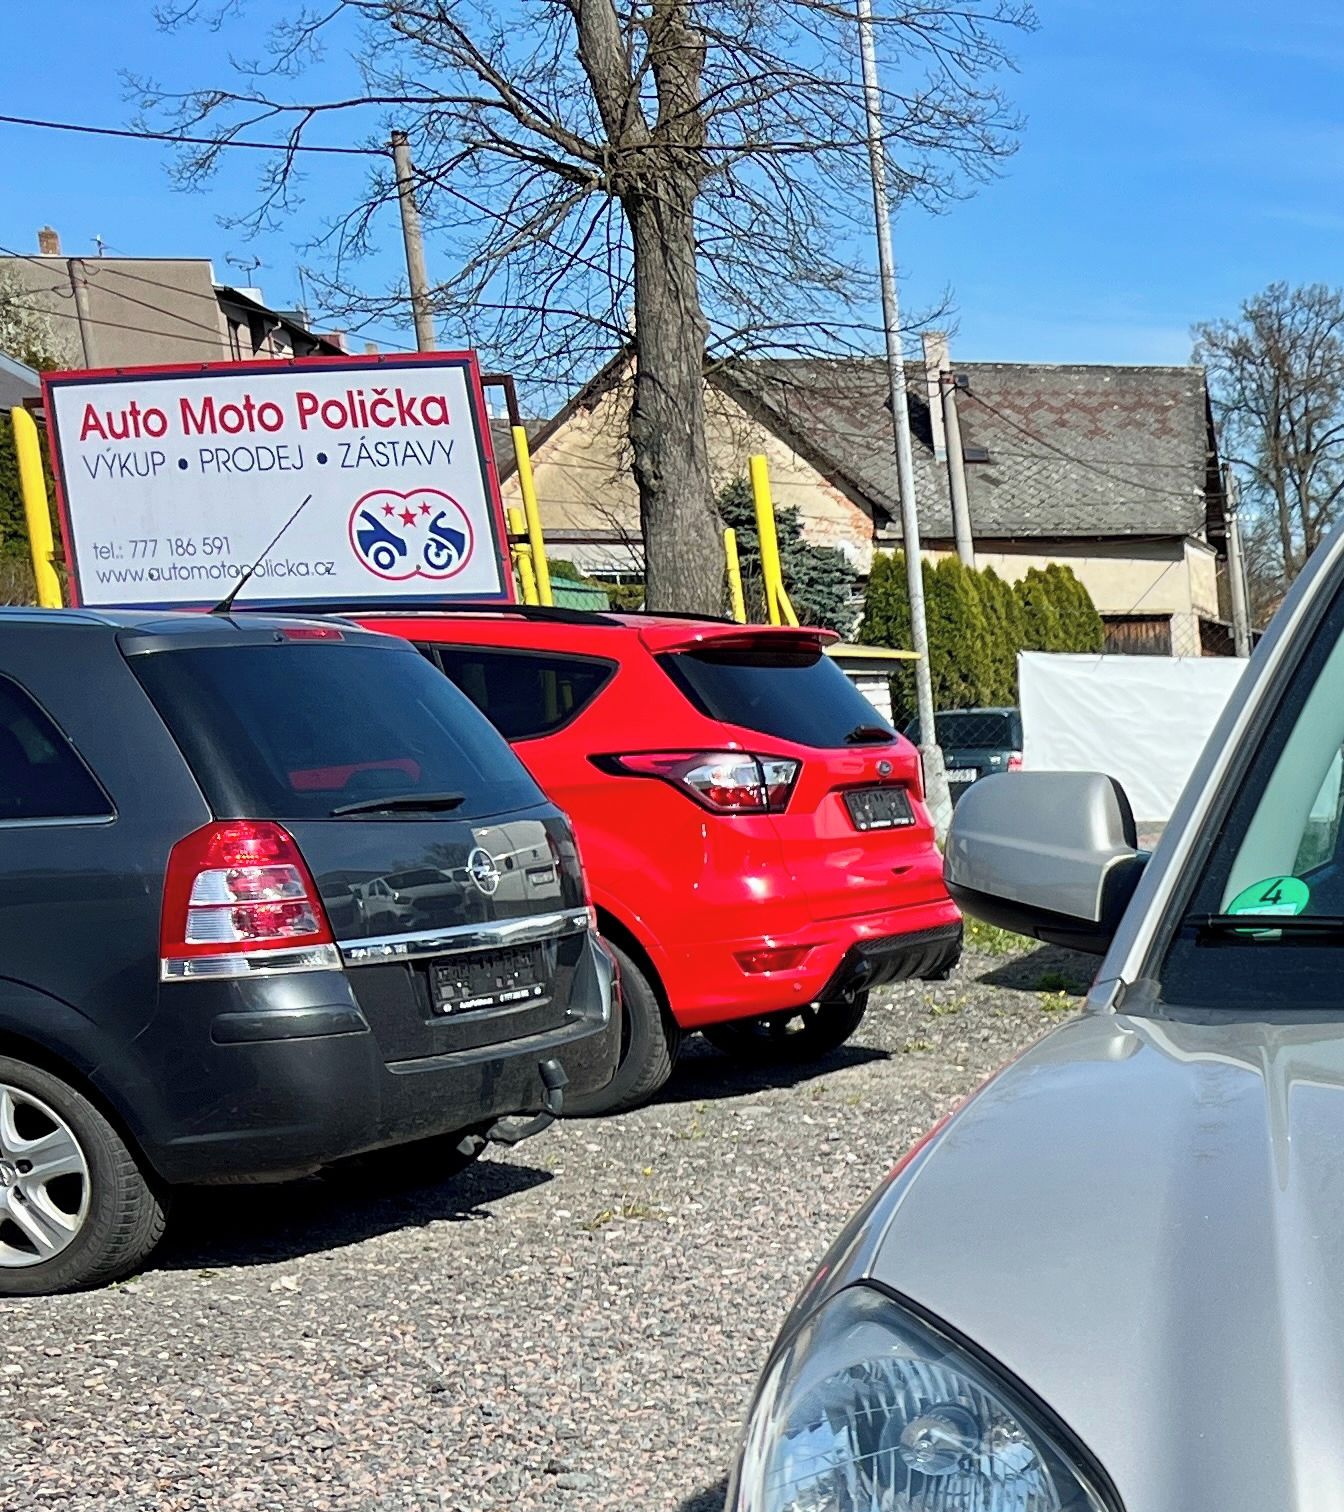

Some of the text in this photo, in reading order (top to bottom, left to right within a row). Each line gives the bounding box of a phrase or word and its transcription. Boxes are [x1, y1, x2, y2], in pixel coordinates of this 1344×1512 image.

[80, 387, 450, 441] Auto Moto Polička
[82, 435, 455, 479] VÝKUP PRODEJ ZÁSTAVY
[92, 536, 231, 560] tel.: 777 186 591
[96, 558, 337, 584] www.automotopolicka.cz
[1258, 879, 1285, 905] 4
